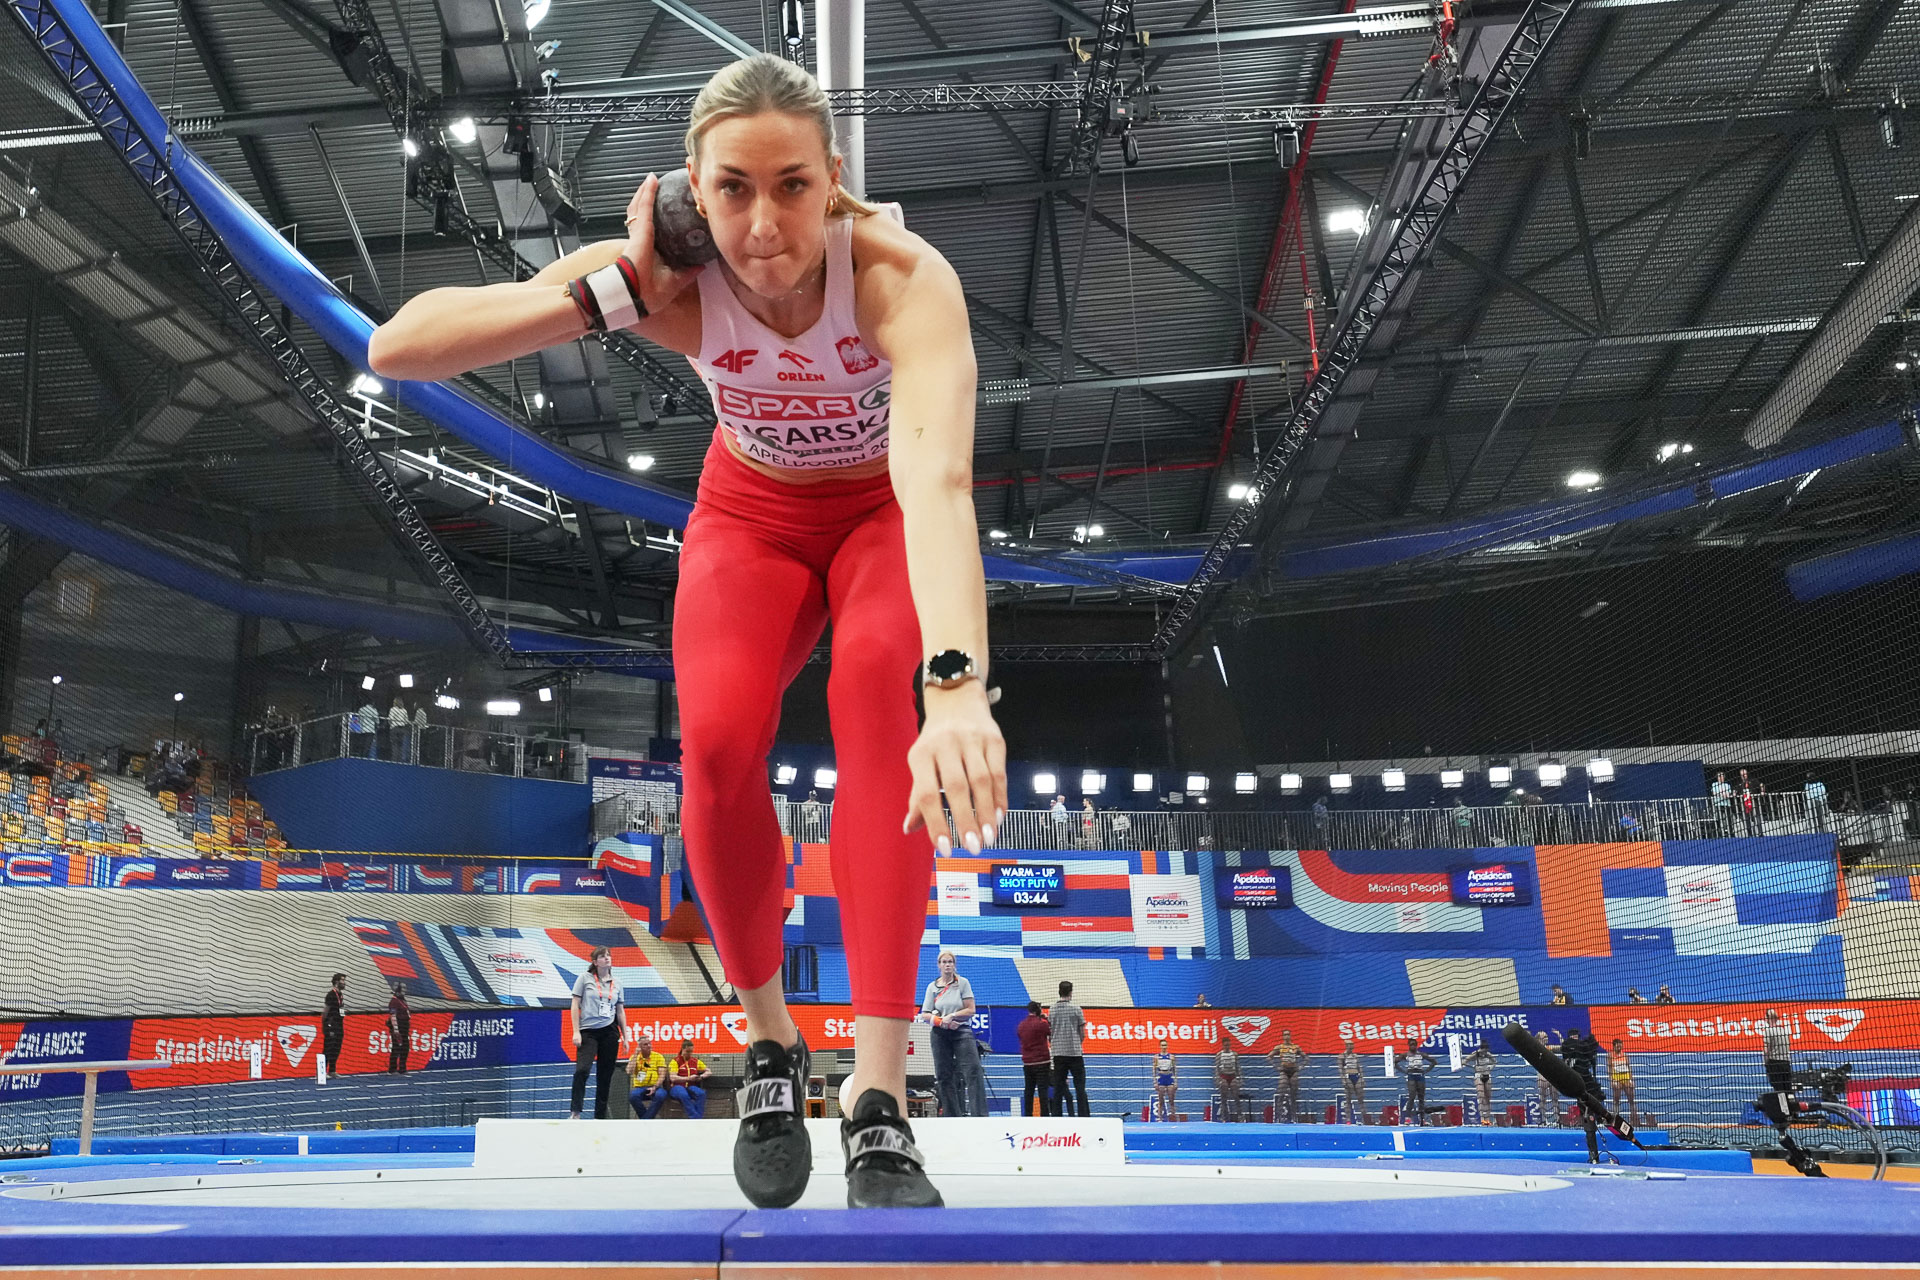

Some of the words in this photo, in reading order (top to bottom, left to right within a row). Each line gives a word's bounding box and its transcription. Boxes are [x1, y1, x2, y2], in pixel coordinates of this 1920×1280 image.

[712, 350, 759, 374] 4F
[777, 372, 825, 382] ORLEN
[722, 389, 853, 418] SPAR
[1001, 868, 1034, 877] WARM
[1042, 868, 1056, 878] UP
[999, 879, 1025, 888] SHOT
[1028, 879, 1046, 888] PUT
[1048, 879, 1058, 888] W
[1368, 883, 1408, 896] Moving
[1411, 881, 1449, 895] People
[1013, 892, 1049, 904] 03:44
[1085, 1019, 1218, 1044] taatsloterij
[745, 1082, 789, 1115] NIKE
[1530, 1101, 1540, 1115] 2
[857, 1129, 912, 1156] NIKE
[1022, 1132, 1082, 1151] polanik
